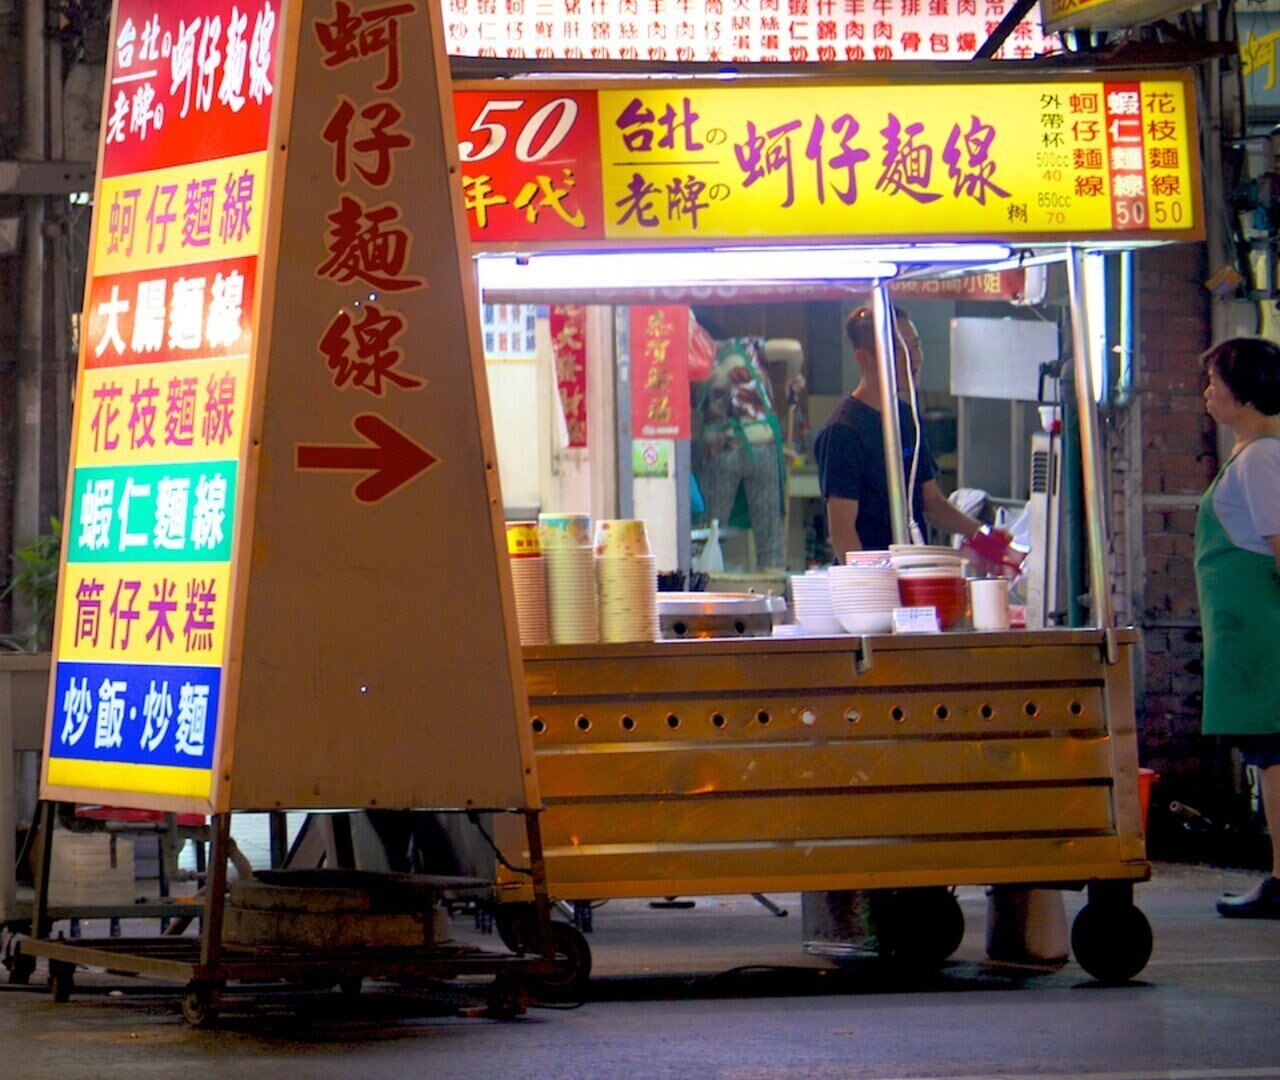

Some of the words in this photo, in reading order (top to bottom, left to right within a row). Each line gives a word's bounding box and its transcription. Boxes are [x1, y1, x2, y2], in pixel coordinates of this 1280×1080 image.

[169, 0, 276, 119] 蚵仔麵線
[459, 96, 580, 164] 50
[615, 96, 728, 155] 台北の
[734, 113, 1014, 210] 蚵仔麵線
[1069, 93, 1105, 197] 蚵仔麵線
[1145, 92, 1181, 197] 花枝麵線
[106, 168, 256, 258] 蚵仔麵線
[313, 0, 428, 396] 蚵仔麵線
[614, 172, 732, 231] 老牌の
[1042, 170, 1063, 182] 40
[1046, 211, 1066, 225] 70
[94, 269, 244, 357] 大腸麵線
[91, 371, 237, 453] 花枝麵線
[78, 473, 228, 551] 蝦仁麵線
[74, 577, 217, 653] 筒仔米糕
